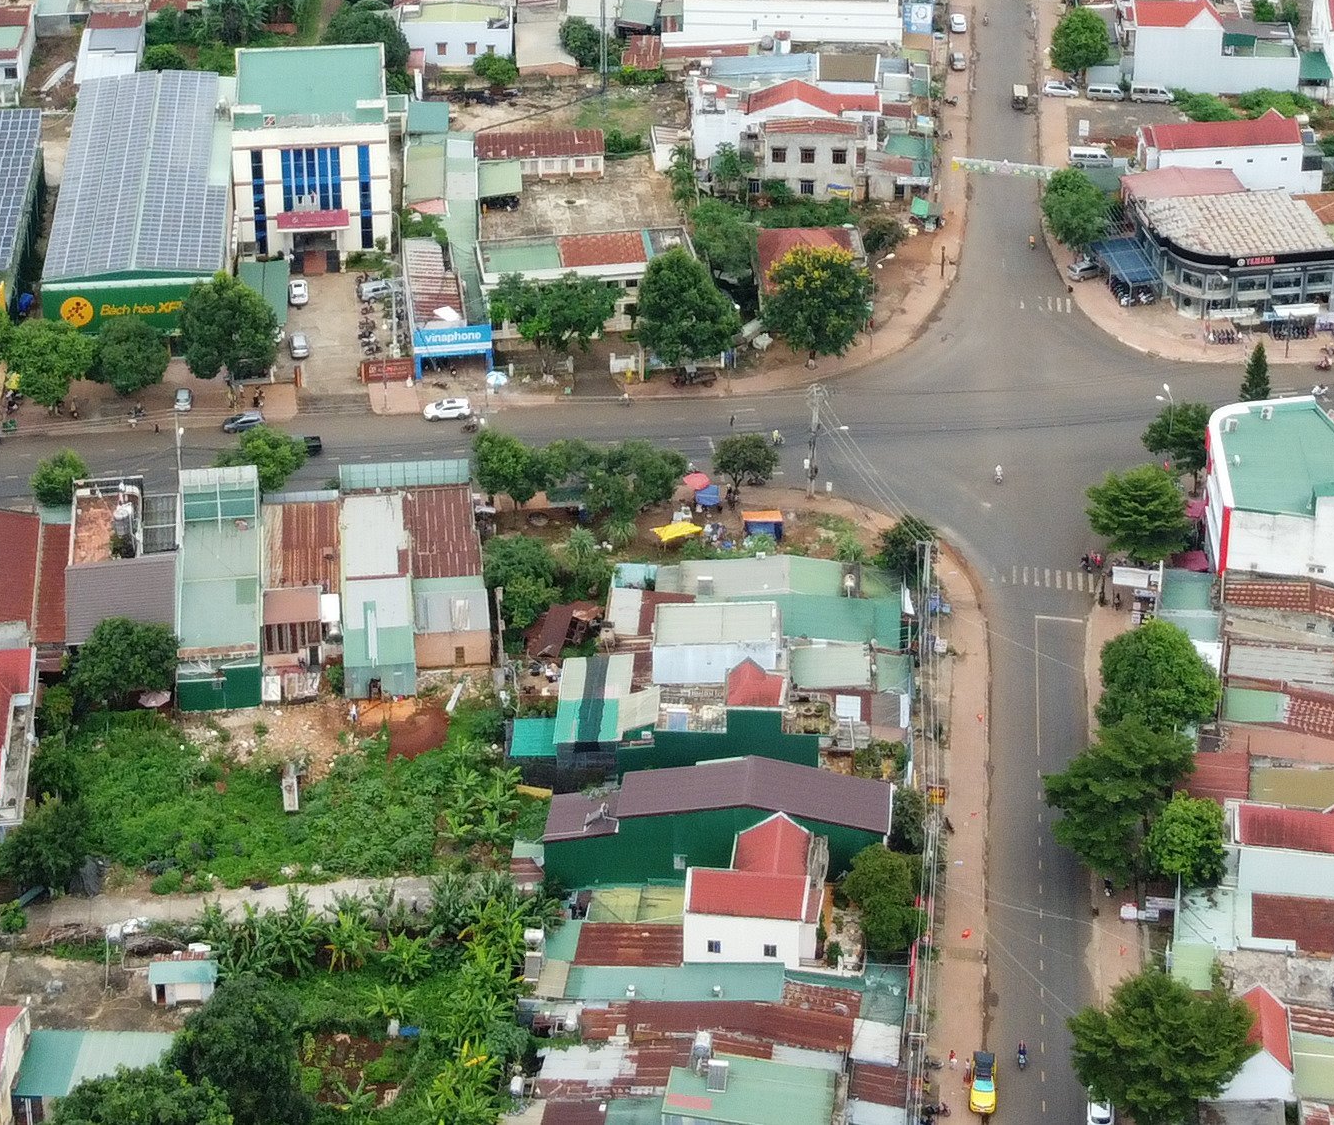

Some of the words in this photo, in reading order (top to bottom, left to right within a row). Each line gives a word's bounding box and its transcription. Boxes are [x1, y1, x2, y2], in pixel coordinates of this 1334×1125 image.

[1245, 255, 1276, 266] YAMAHA
[100, 304, 131, 316] Bách
[133, 303, 155, 314] hóa
[424, 330, 482, 343] vinaphone
